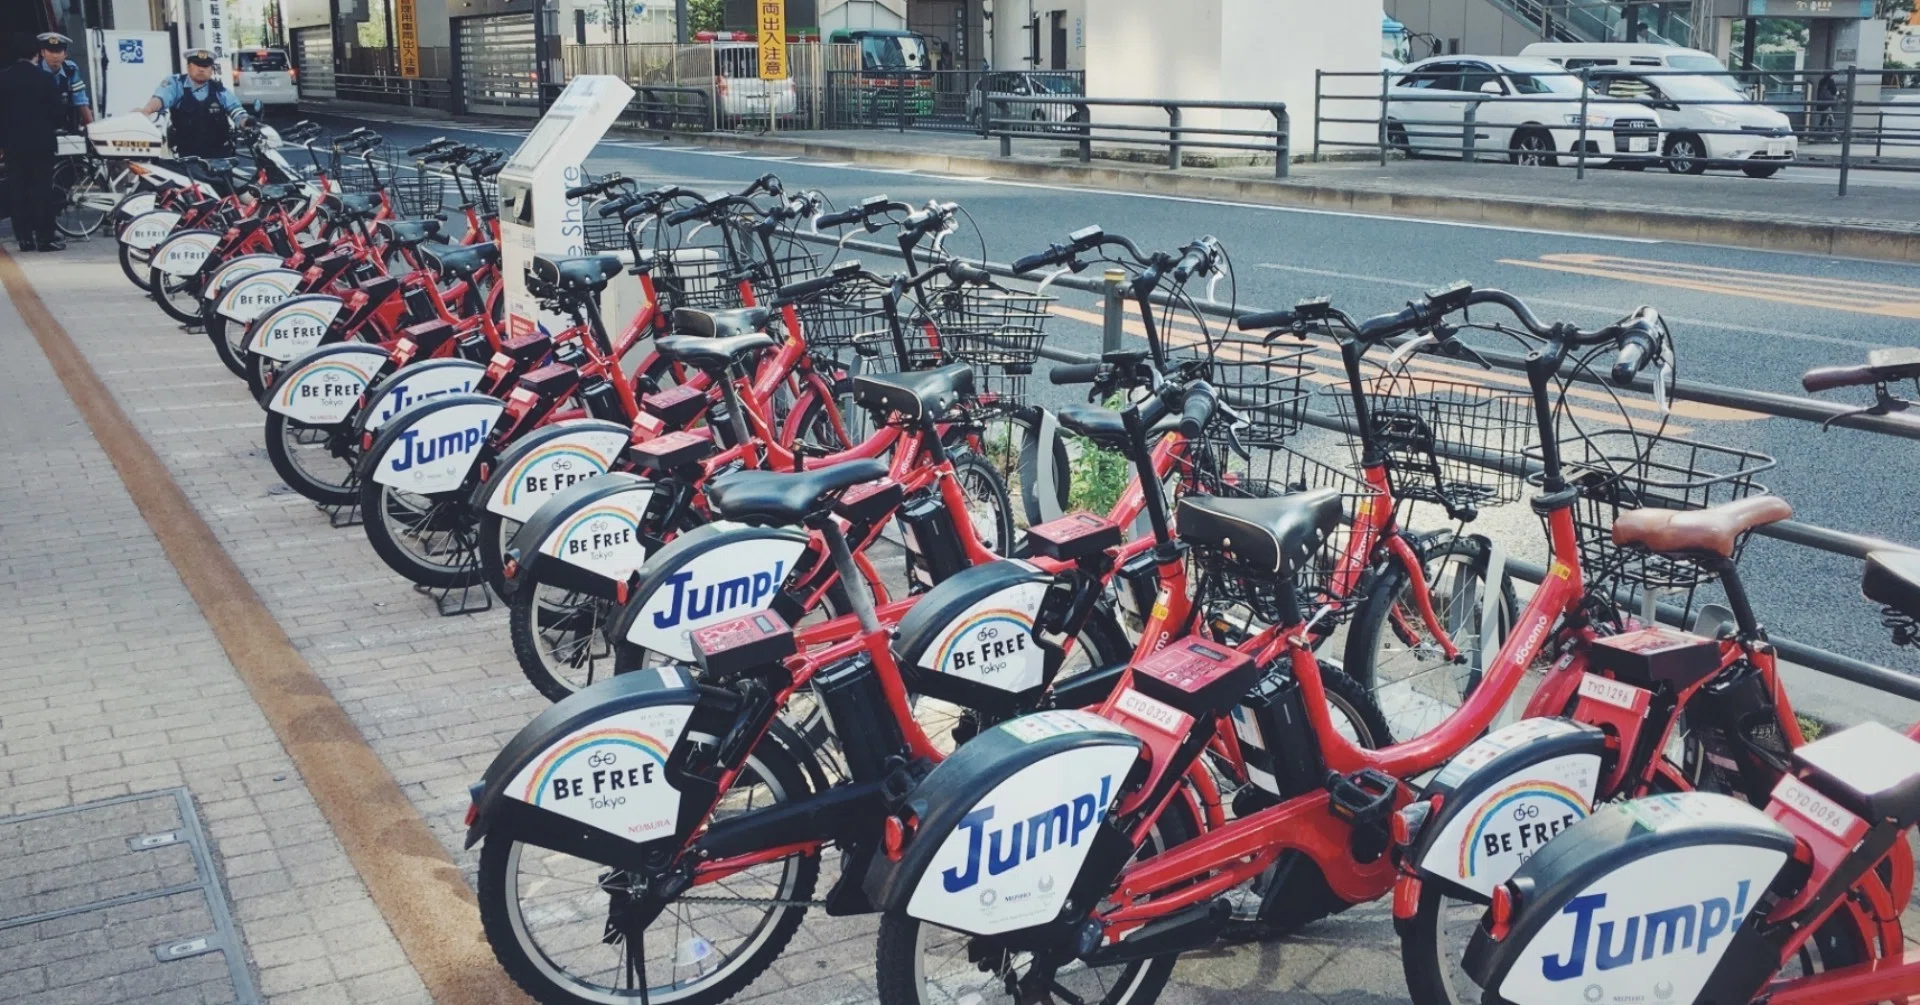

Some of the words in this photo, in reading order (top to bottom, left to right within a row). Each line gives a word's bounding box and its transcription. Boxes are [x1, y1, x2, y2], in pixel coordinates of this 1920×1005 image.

[210, 0, 223, 57] 転車注意
[762, 0, 781, 75] 両出入注意
[240, 295, 253, 304] BE
[274, 329, 288, 339] BE
[293, 326, 322, 338] FREE
[302, 385, 319, 397] BE
[325, 383, 360, 397] FREE
[392, 419, 487, 472] Jump!
[526, 476, 547, 493] BE
[569, 539, 587, 555] BE
[594, 528, 630, 550] FREE
[591, 550, 613, 560] Tokyo
[653, 560, 784, 630] Jump!
[953, 652, 976, 670] BE
[981, 633, 1025, 662] FREE
[1514, 615, 1548, 665] docomo
[980, 661, 1007, 675] Tokyo
[553, 776, 584, 801] BE
[592, 762, 655, 794] FREE
[588, 794, 626, 810] Tokyo
[628, 819, 671, 832] NOMURA
[941, 774, 1112, 893] Jump!
[1484, 832, 1512, 857] BE
[1541, 879, 1751, 982] Jump!
